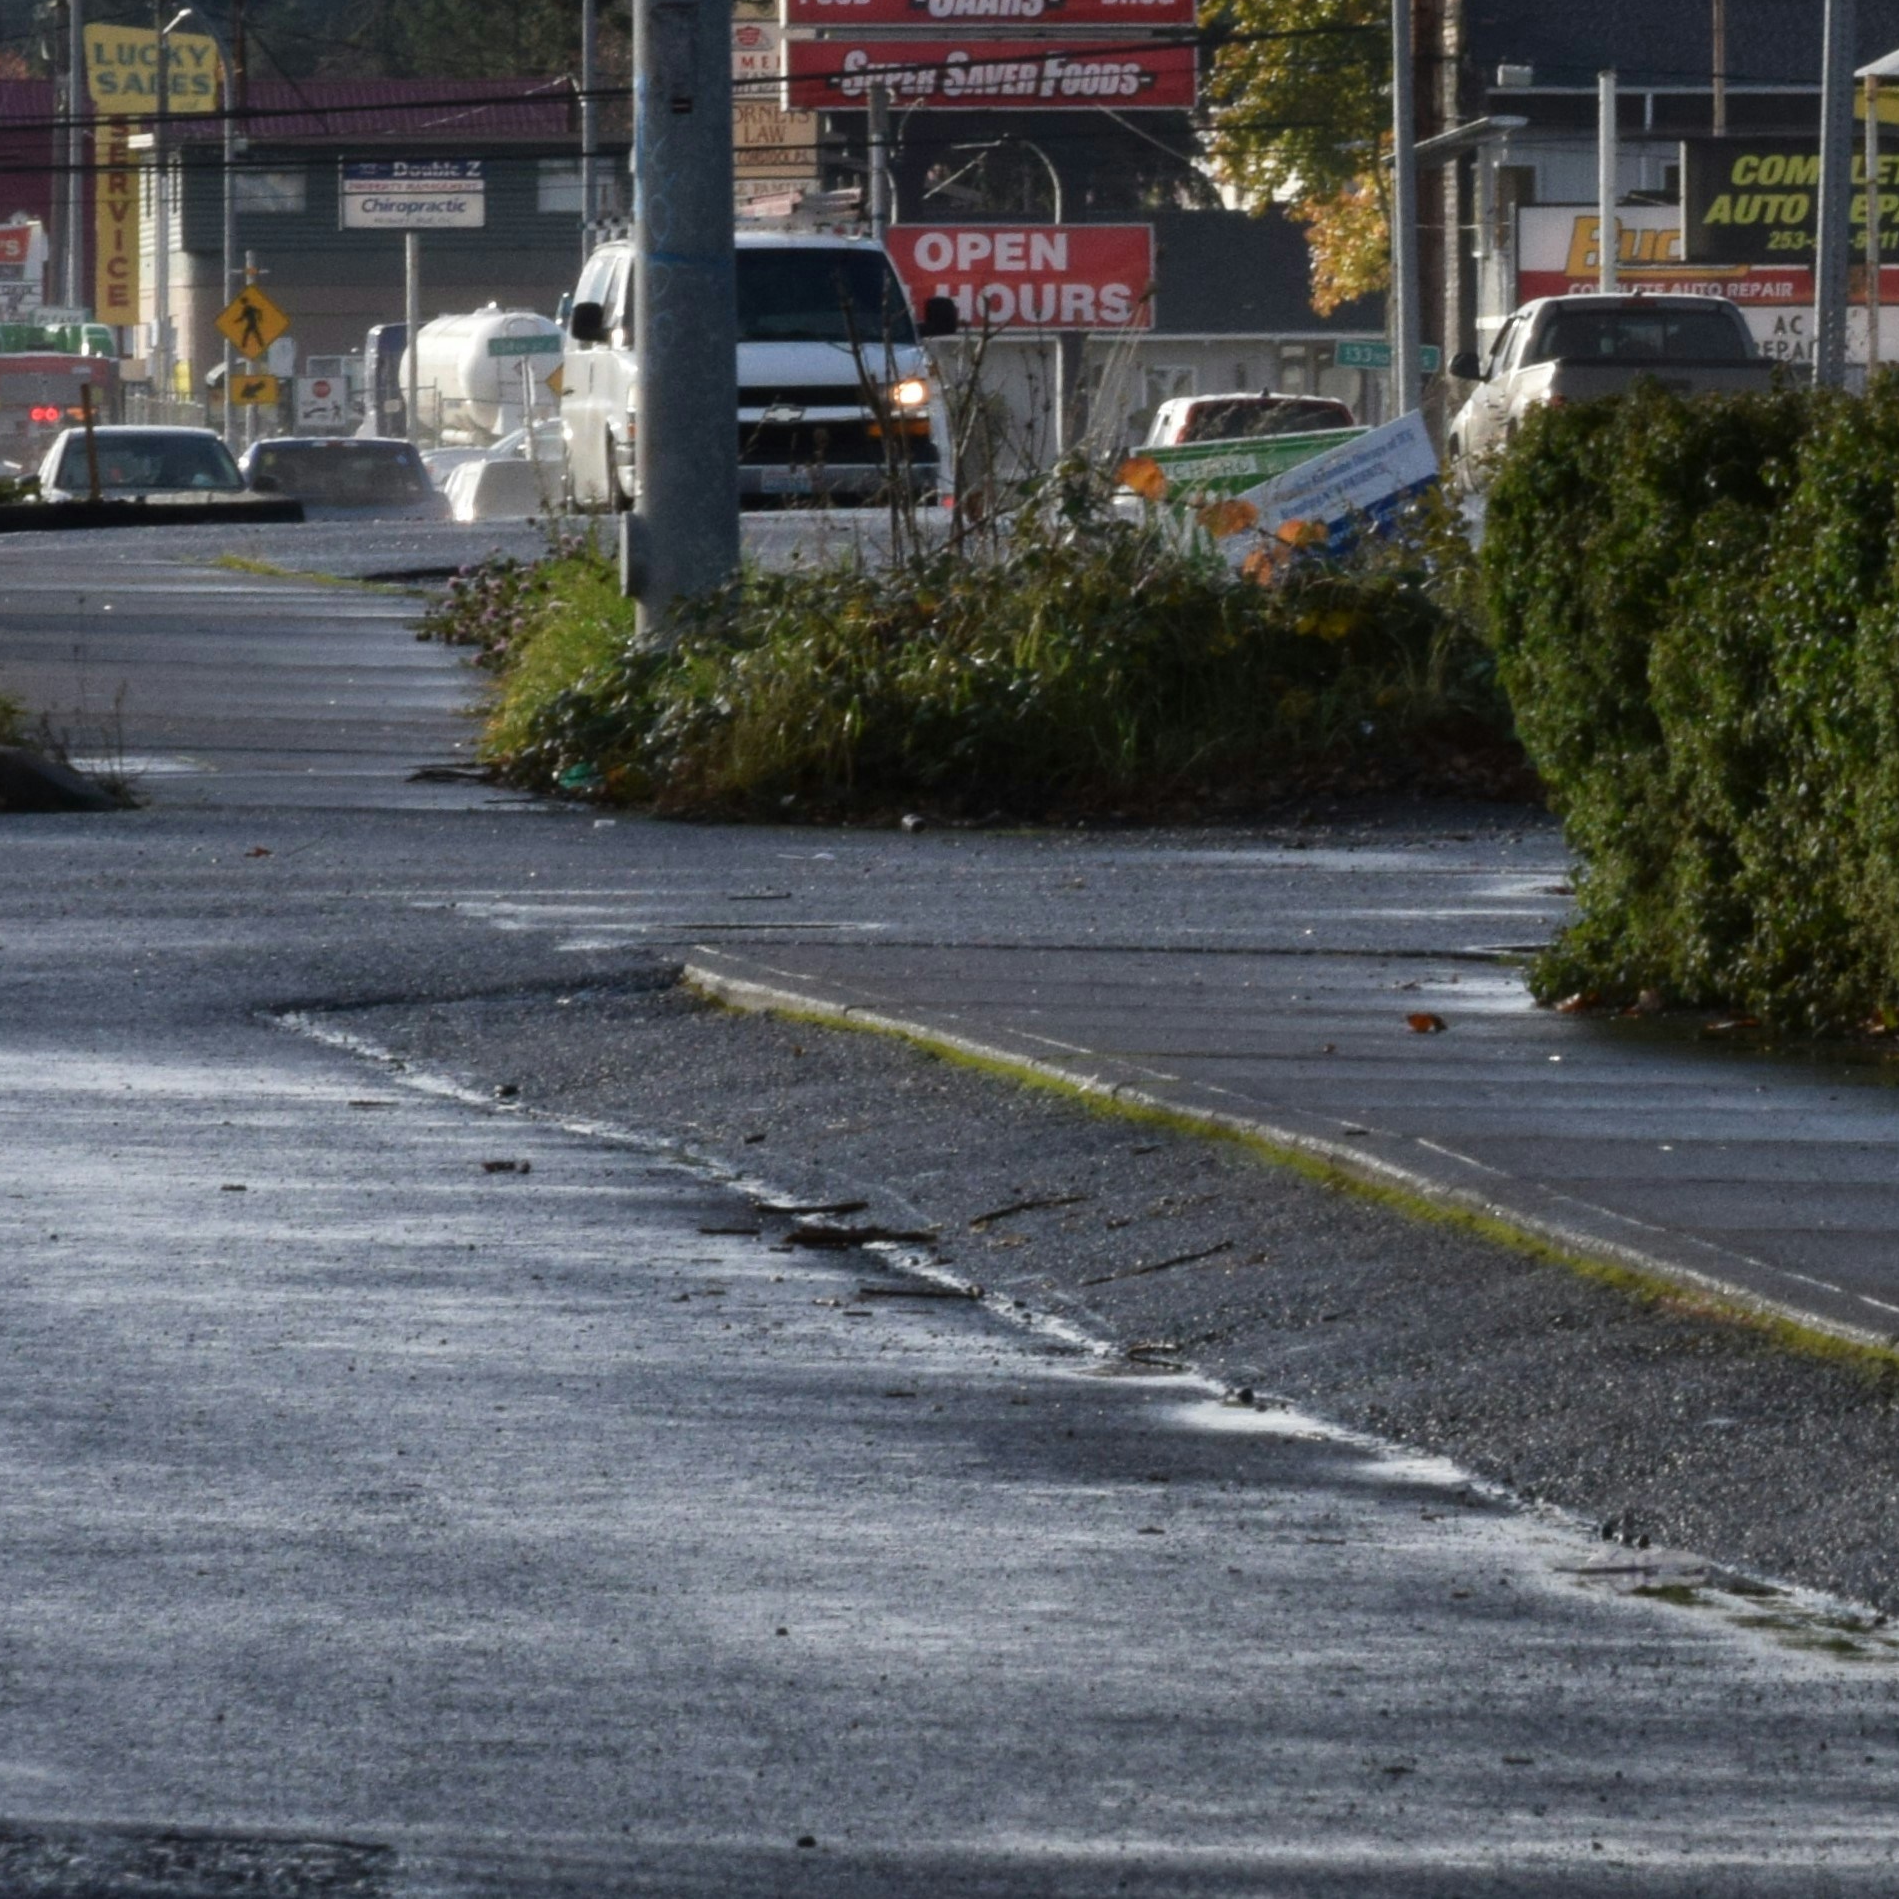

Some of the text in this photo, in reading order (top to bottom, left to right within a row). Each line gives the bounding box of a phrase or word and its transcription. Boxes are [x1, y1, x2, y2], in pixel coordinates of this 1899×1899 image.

[93, 42, 211, 67] LUCKY
[744, 125, 787, 144] LAW
[392, 160, 482, 178] Double Z
[106, 112, 131, 308] SERVICE
[361, 197, 467, 216] Chiropractic
[1703, 193, 1810, 224] AUTO
[913, 231, 1069, 272] OPEN
[1674, 282, 1722, 296] AUTO
[1727, 282, 1794, 298] REPAIR
